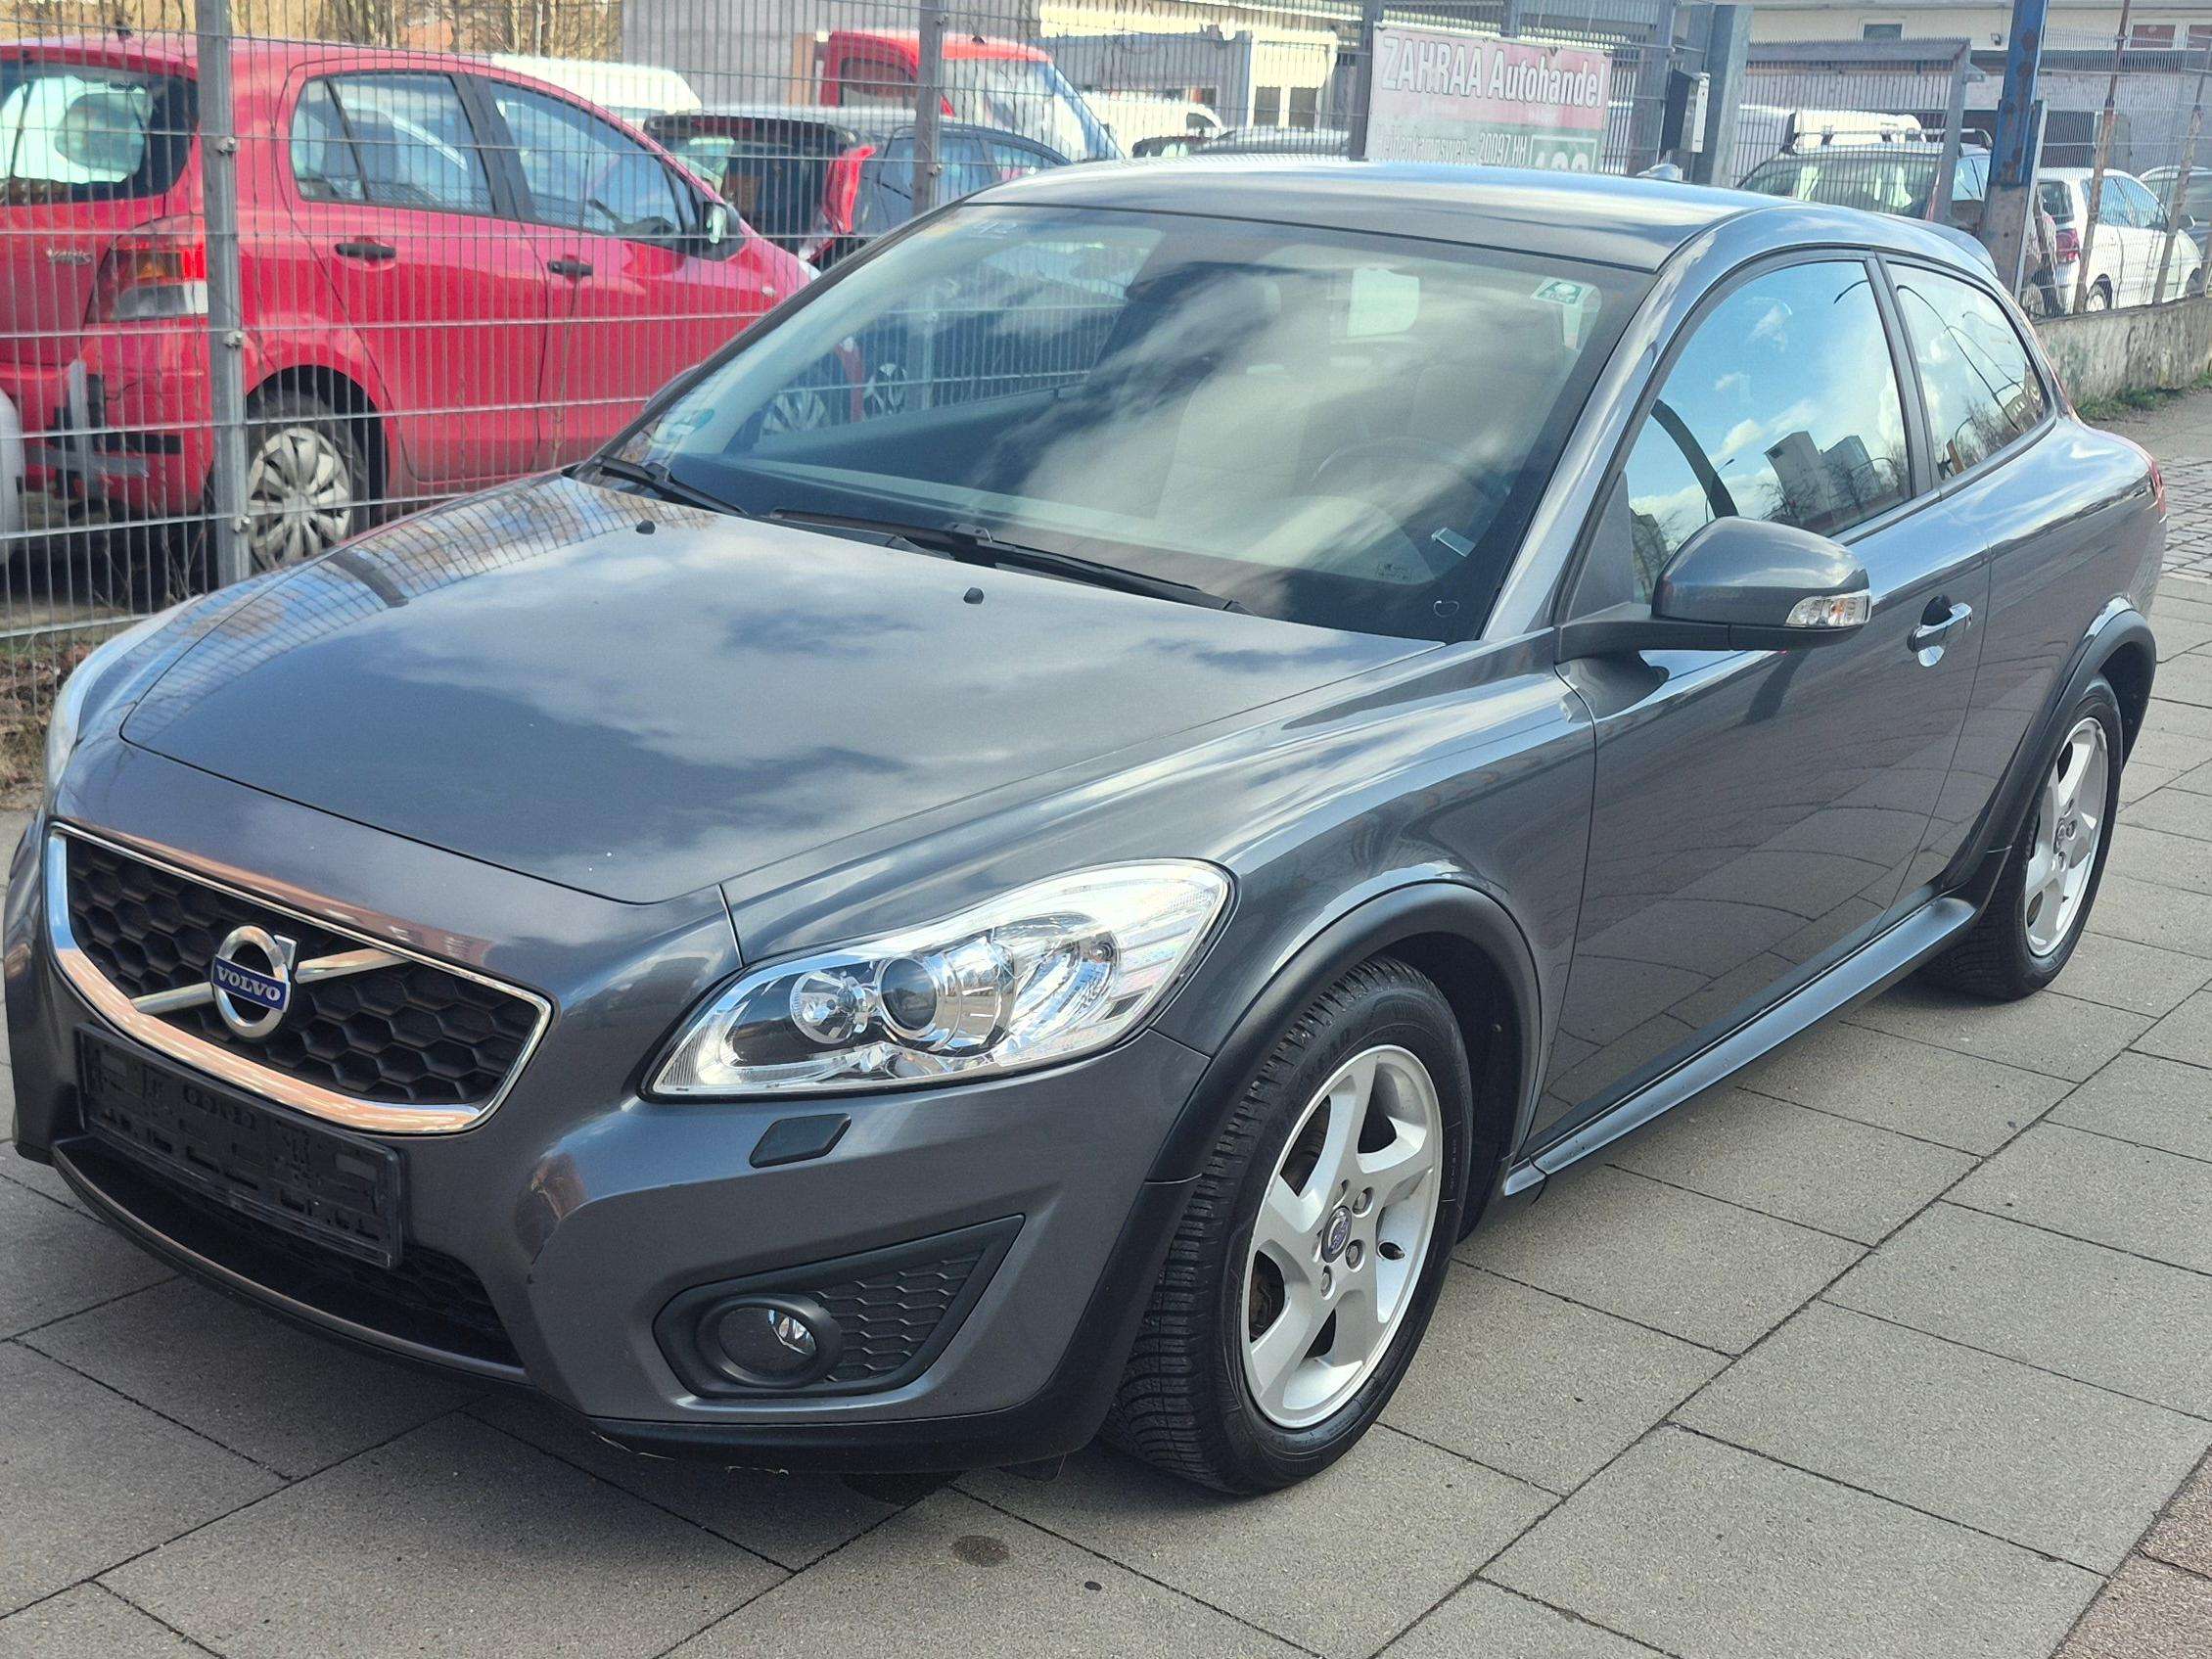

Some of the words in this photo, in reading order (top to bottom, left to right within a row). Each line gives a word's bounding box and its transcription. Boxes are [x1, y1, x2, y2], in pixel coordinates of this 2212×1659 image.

[1381, 36, 1483, 97] ZAHRAA
[1487, 49, 1606, 109] Autohandel
[1479, 131, 1510, 165] 20097
[1511, 134, 1528, 166] HH
[215, 963, 282, 1001] VOLVO
